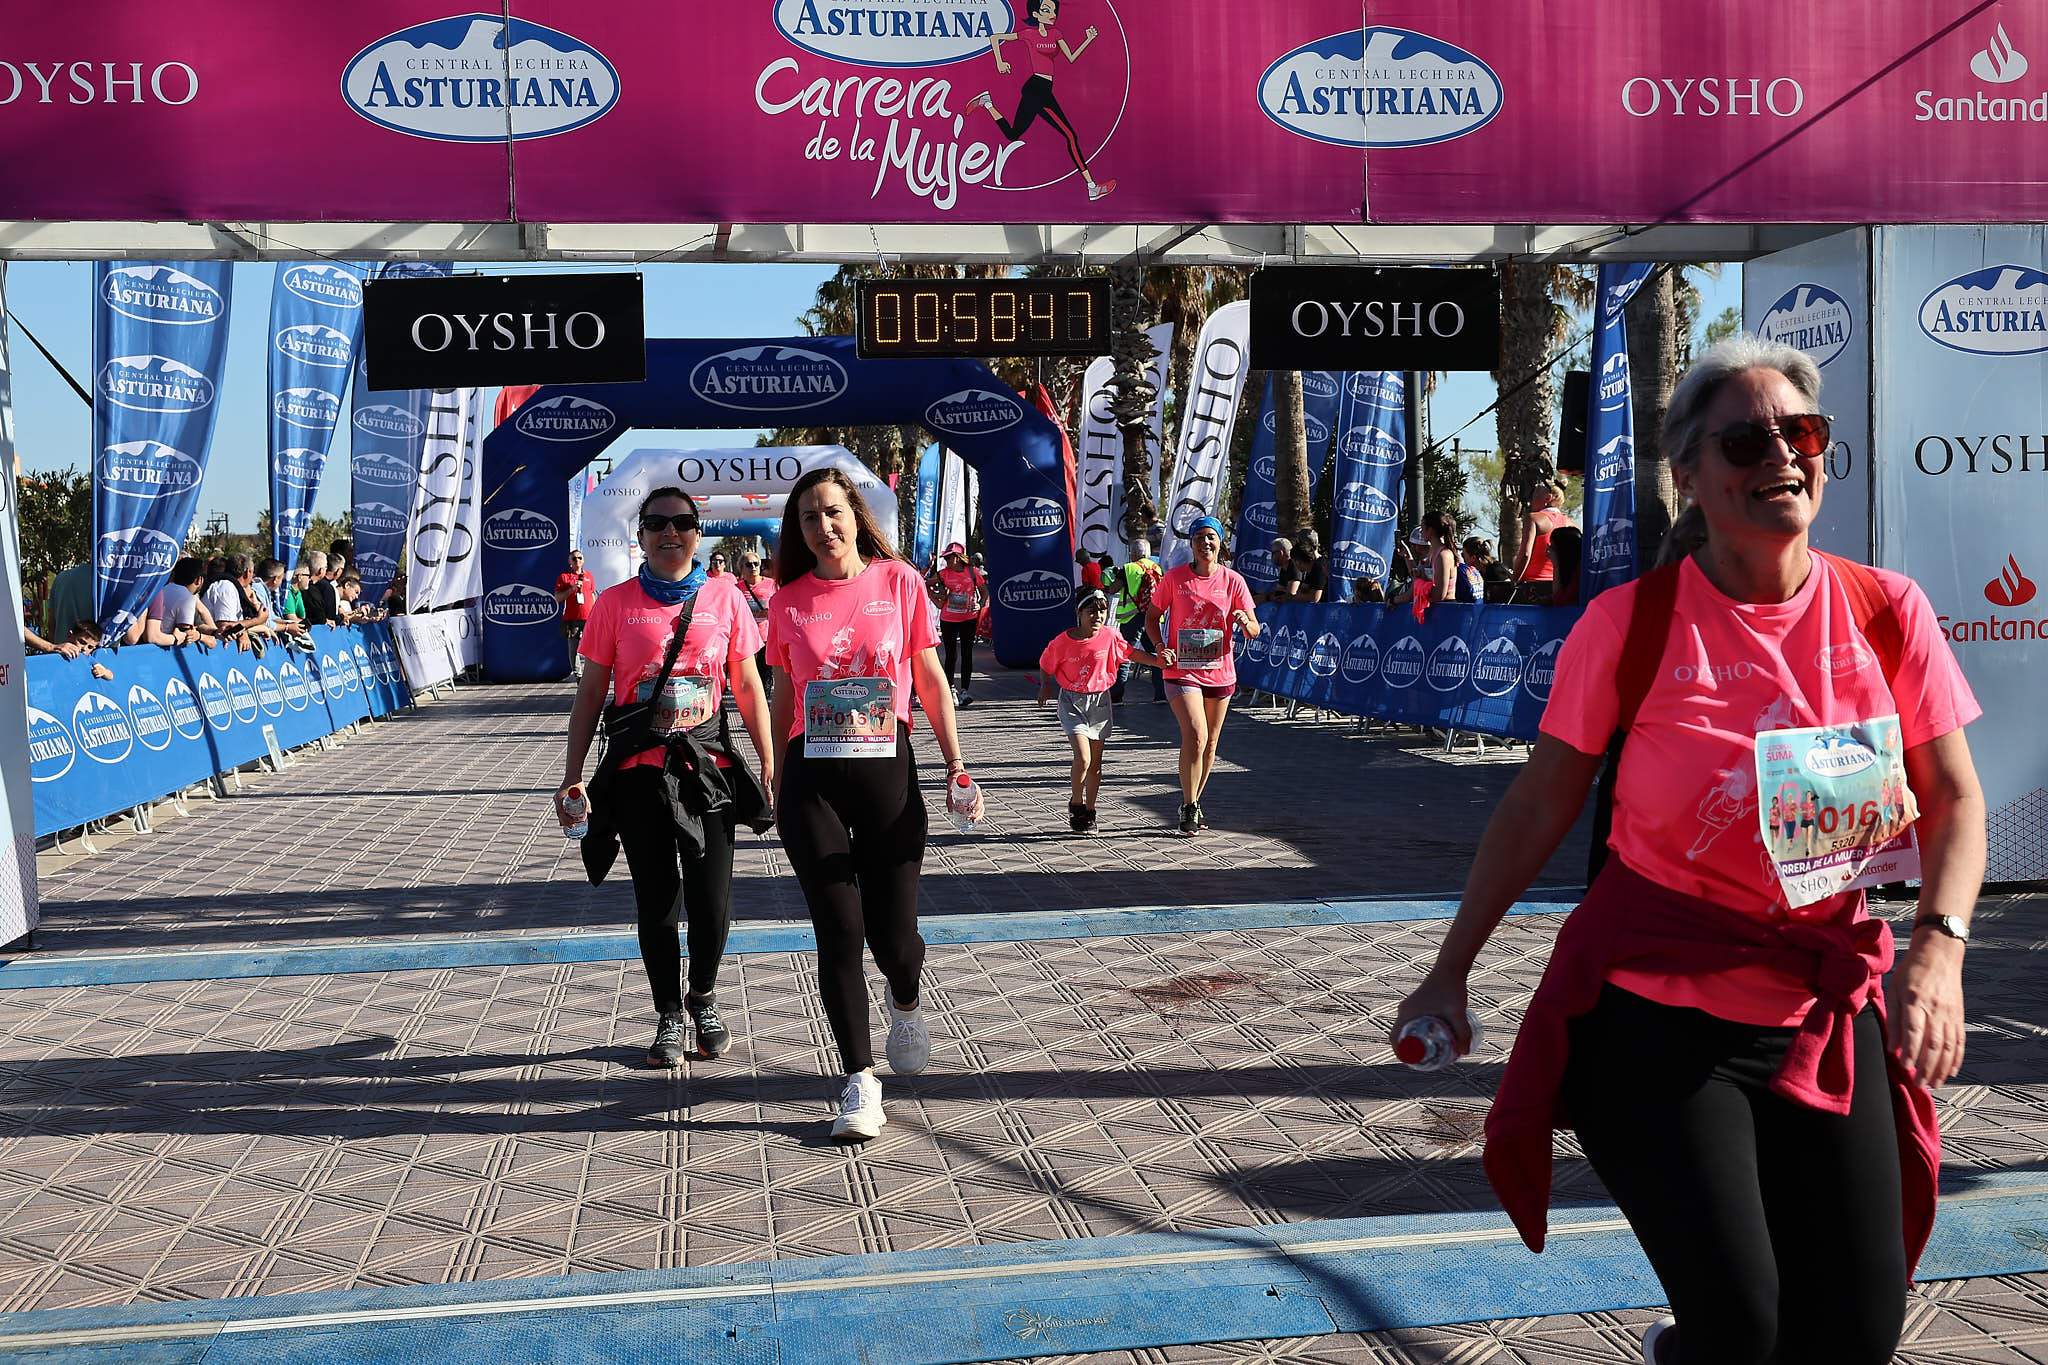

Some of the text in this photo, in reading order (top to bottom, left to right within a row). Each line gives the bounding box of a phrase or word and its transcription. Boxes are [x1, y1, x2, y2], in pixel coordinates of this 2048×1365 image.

[793, 0, 994, 38] ASTURIANA
[405, 58, 493, 70] CENTRAL
[1315, 68, 1477, 80] CENTRAL LECHERA
[364, 60, 600, 108] ASTURIANA
[755, 57, 952, 118] Carrera
[1277, 70, 1485, 116] ASTURIANA
[1621, 77, 1804, 117] OYSHO
[1915, 90, 2048, 122] Santand
[804, 118, 876, 161] de la
[871, 113, 1026, 210] Mujer
[124, 280, 162, 292] CENTRAL
[107, 278, 215, 316] ASTURIANA
[1958, 296, 2014, 306] CENTRAL
[875, 293, 1092, 343] 00:58:47
[1291, 300, 1465, 338] OYSHO
[1775, 307, 1841, 329] CENTRAL LECHERA
[411, 311, 606, 352] OYSHO
[118, 369, 161, 381] CENTRAL
[725, 364, 831, 372] CENTRAL LECHERA
[105, 369, 207, 404] ASTURIANA
[702, 366, 837, 394] ASTURIANA
[358, 412, 418, 434] ASTURIANA
[522, 413, 609, 430] ASTURIANA
[933, 407, 1018, 425] ASTURIANA
[1170, 337, 1241, 540] OYSHO
[1914, 434, 2048, 476] OYSH
[352, 461, 411, 481] ASTURIANA
[677, 456, 802, 484] OYSHO
[1080, 389, 1119, 559] OYSHO
[603, 487, 641, 496] OYSHO
[919, 480, 937, 536] Marlene
[354, 515, 405, 530] STURIANA
[998, 513, 1063, 530] ASTURIANA
[486, 526, 554, 541] ASTURIANA
[587, 539, 623, 548] OYSHO
[98, 551, 172, 569] STURANA
[1003, 586, 1068, 602] ASTURIANA
[487, 599, 554, 615] ASTURIANA
[627, 616, 662, 625] OYSHO
[795, 612, 833, 627] OYSHO
[1384, 655, 1421, 676] ASTURIANA
[1428, 655, 1466, 678] ASTURIANA
[1474, 658, 1518, 683] ASTURIANA
[1674, 660, 1752, 683] OYSHO
[832, 687, 867, 696] ASTURIANA
[135, 711, 171, 738] ASTURIANA
[834, 711, 867, 726] 016
[79, 720, 131, 750] ASTURIANA
[814, 745, 842, 753] OYSHO
[1765, 750, 1793, 762] SUMA
[1811, 751, 1873, 770] ASTURIANA
[1818, 800, 1879, 833] 016
[1831, 835, 1856, 853] 5320
[1812, 860, 1822, 870] DE
[1823, 855, 1834, 866] LA
[1853, 861, 1898, 879] ntander
